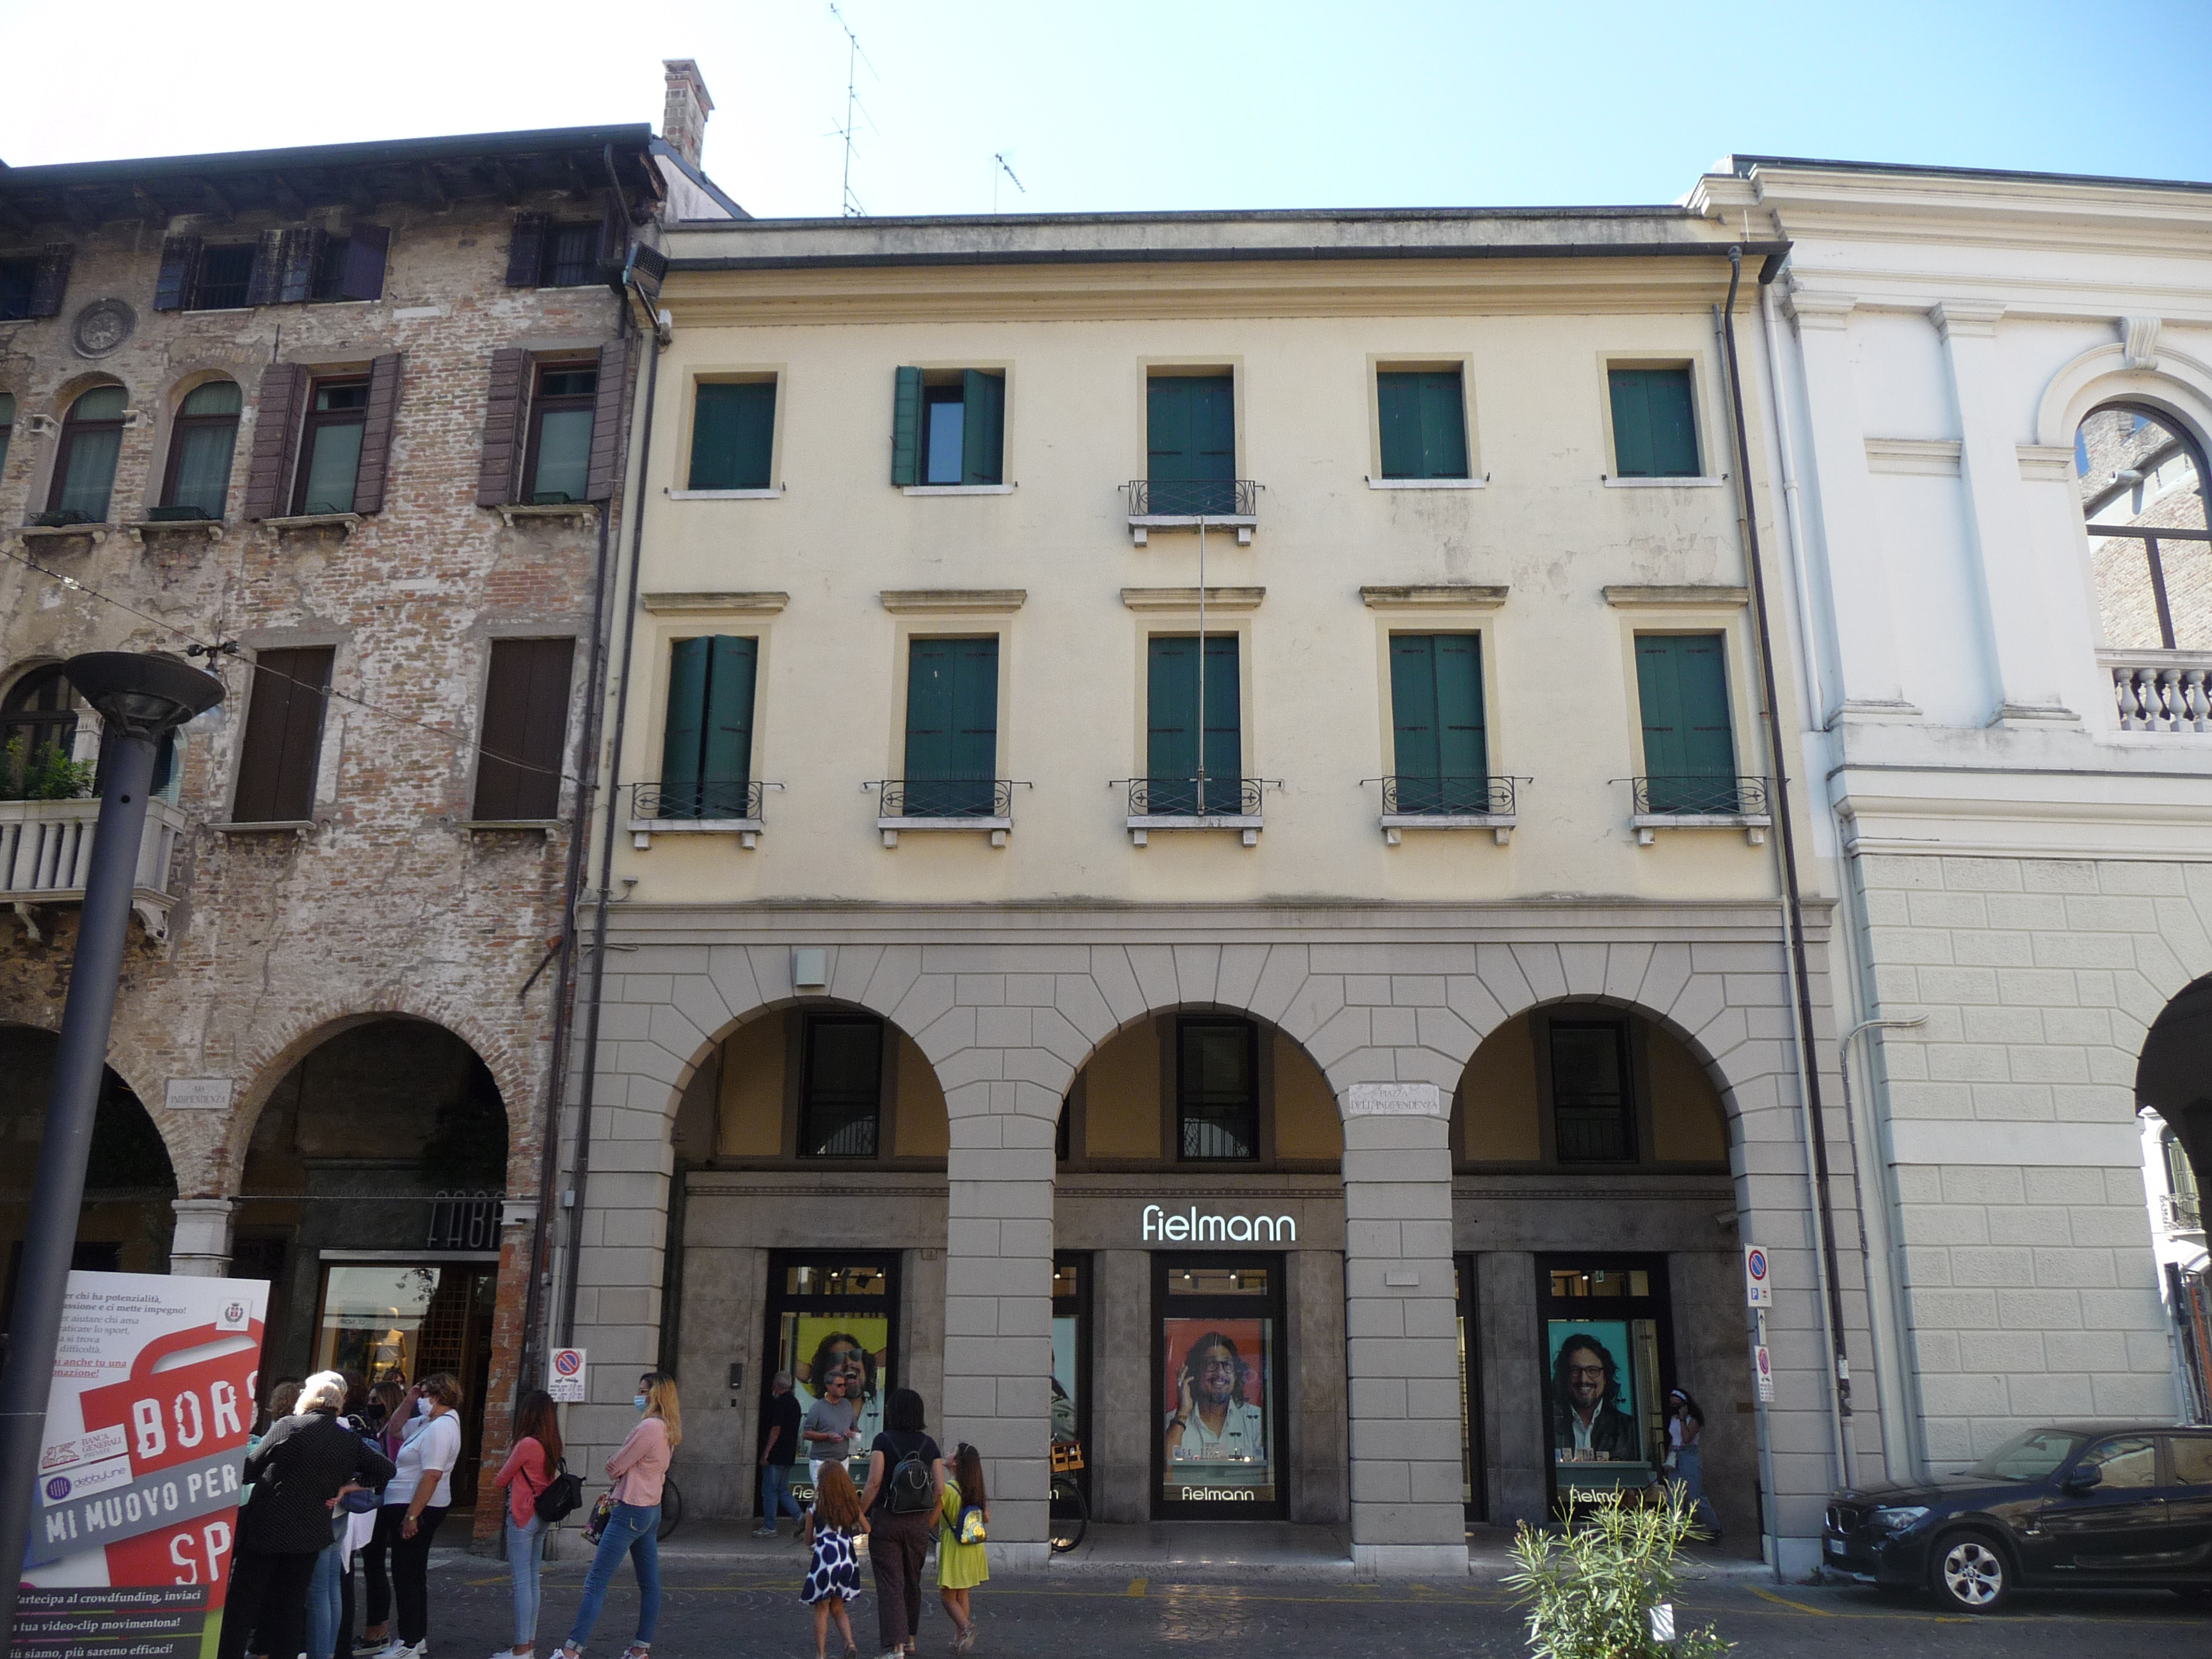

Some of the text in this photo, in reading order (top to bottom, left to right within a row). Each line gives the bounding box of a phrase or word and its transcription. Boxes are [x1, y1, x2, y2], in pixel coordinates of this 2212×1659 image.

[170, 1095, 225, 1103] INDIPENDENZA
[1142, 1205, 1296, 1241] fielmann
[76, 1292, 90, 1300] chi
[92, 1292, 103, 1301] ha
[106, 1294, 162, 1303] potenzialità,
[63, 1302, 97, 1311] assione
[144, 1306, 187, 1315] impegno!
[104, 1315, 118, 1324] chi
[60, 1345, 102, 1353] difficoltà.
[64, 1358, 93, 1366] anche
[53, 1369, 99, 1377] onazione!
[81, 1434, 109, 1446] BANCA
[83, 1437, 122, 1452] GENERALI
[1182, 1486, 1254, 1501] fielmann
[45, 1464, 238, 1543] MI MUOVO PER
[17, 1590, 202, 1607] artecipa al crowdfunding, inviaci
[20, 1622, 38, 1631] tua
[42, 1619, 99, 1633] video-clip
[101, 1618, 180, 1629] movimentona!
[25, 1647, 62, 1659] siamo,
[65, 1646, 84, 1659] più
[87, 1647, 127, 1656] saremo
[129, 1644, 173, 1654] efficaci!
